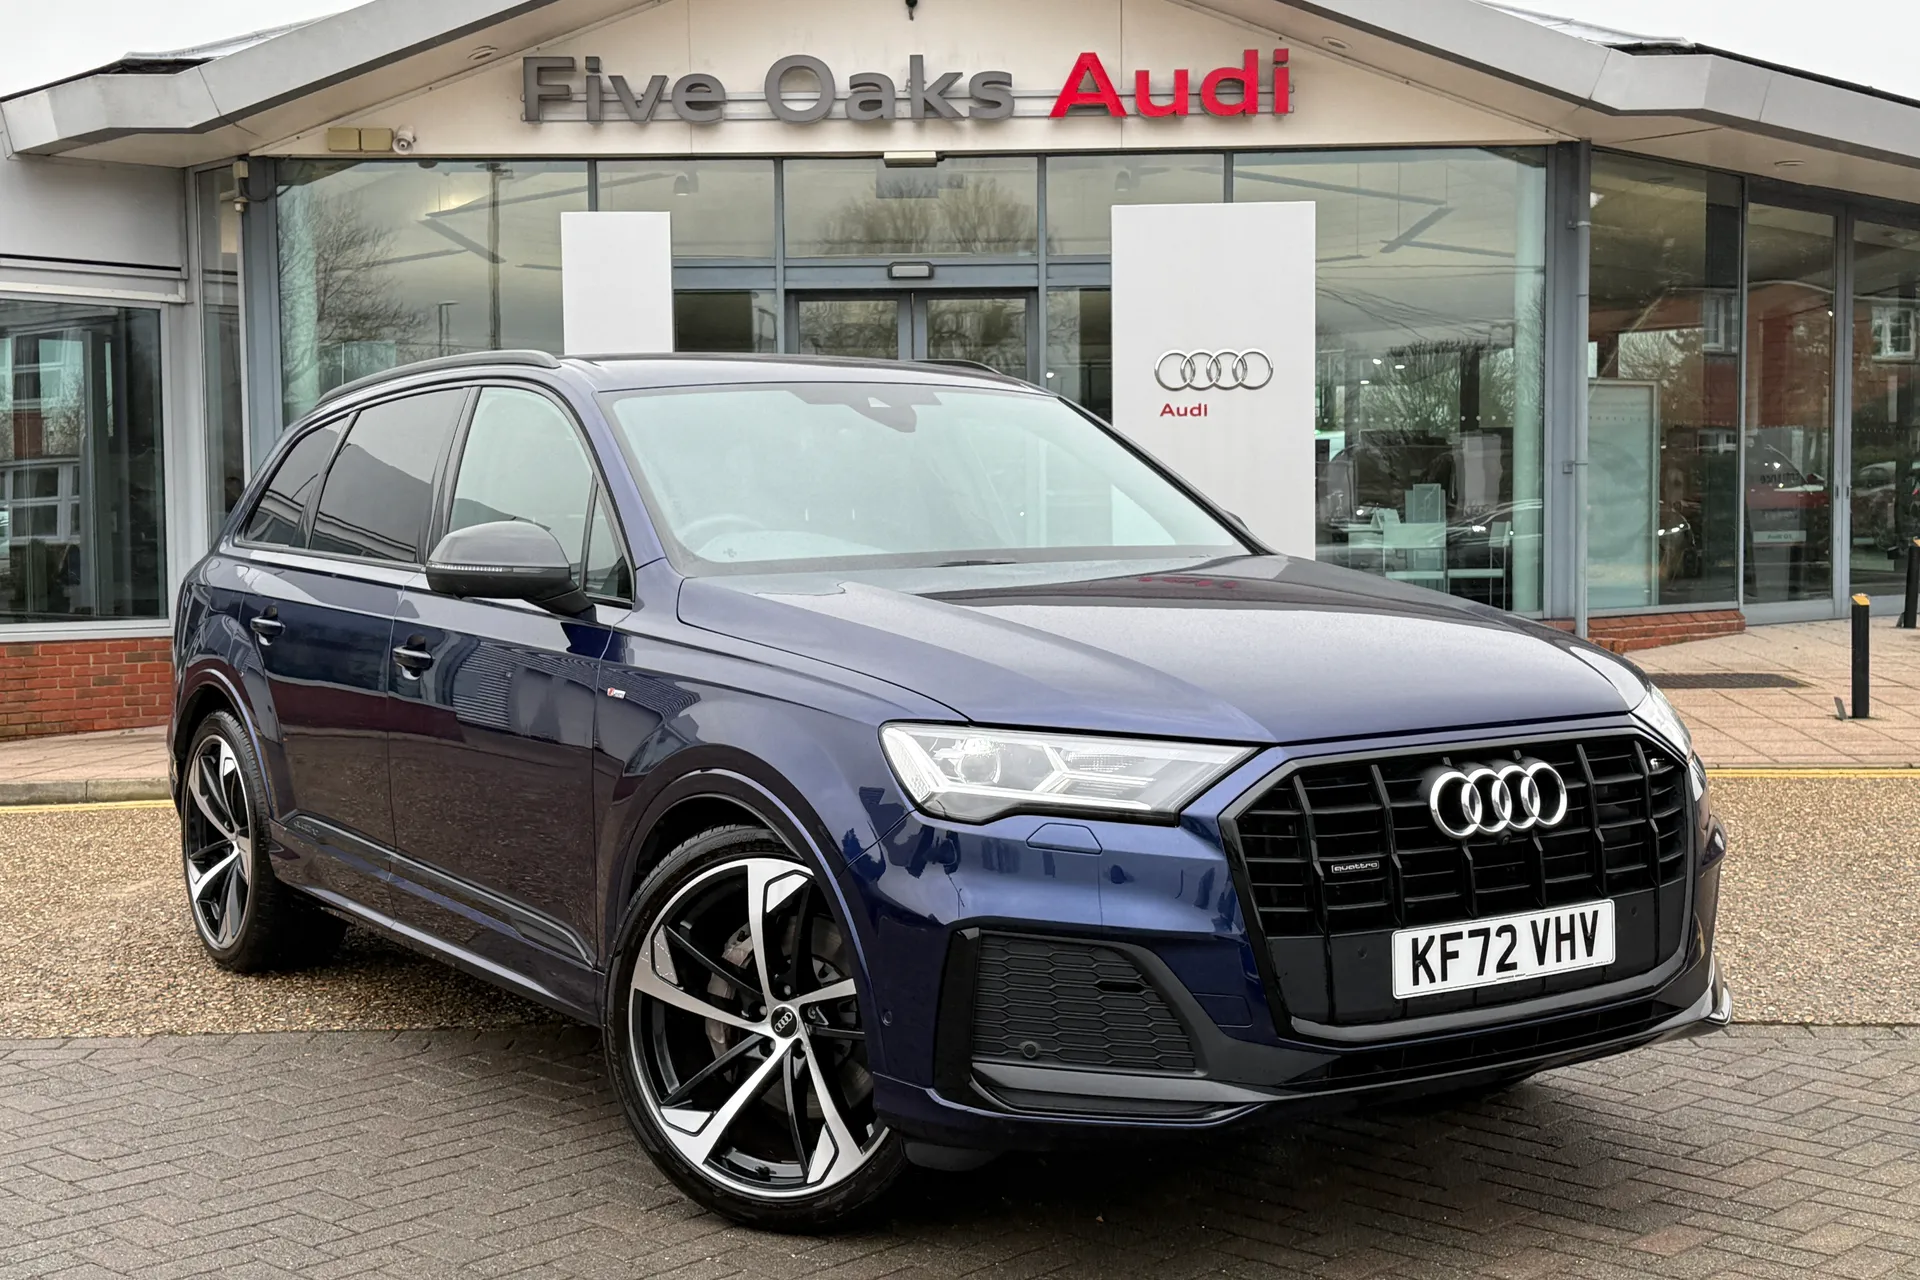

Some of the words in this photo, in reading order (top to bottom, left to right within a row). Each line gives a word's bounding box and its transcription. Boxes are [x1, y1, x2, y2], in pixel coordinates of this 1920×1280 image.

[522, 56, 727, 124] Five
[764, 54, 1015, 123] Oaks
[1049, 48, 1290, 119] Audi
[1159, 403, 1208, 417] Audi
[1333, 862, 1378, 872] quattro
[1411, 924, 1518, 986] KF72
[1530, 910, 1599, 966] VHV
